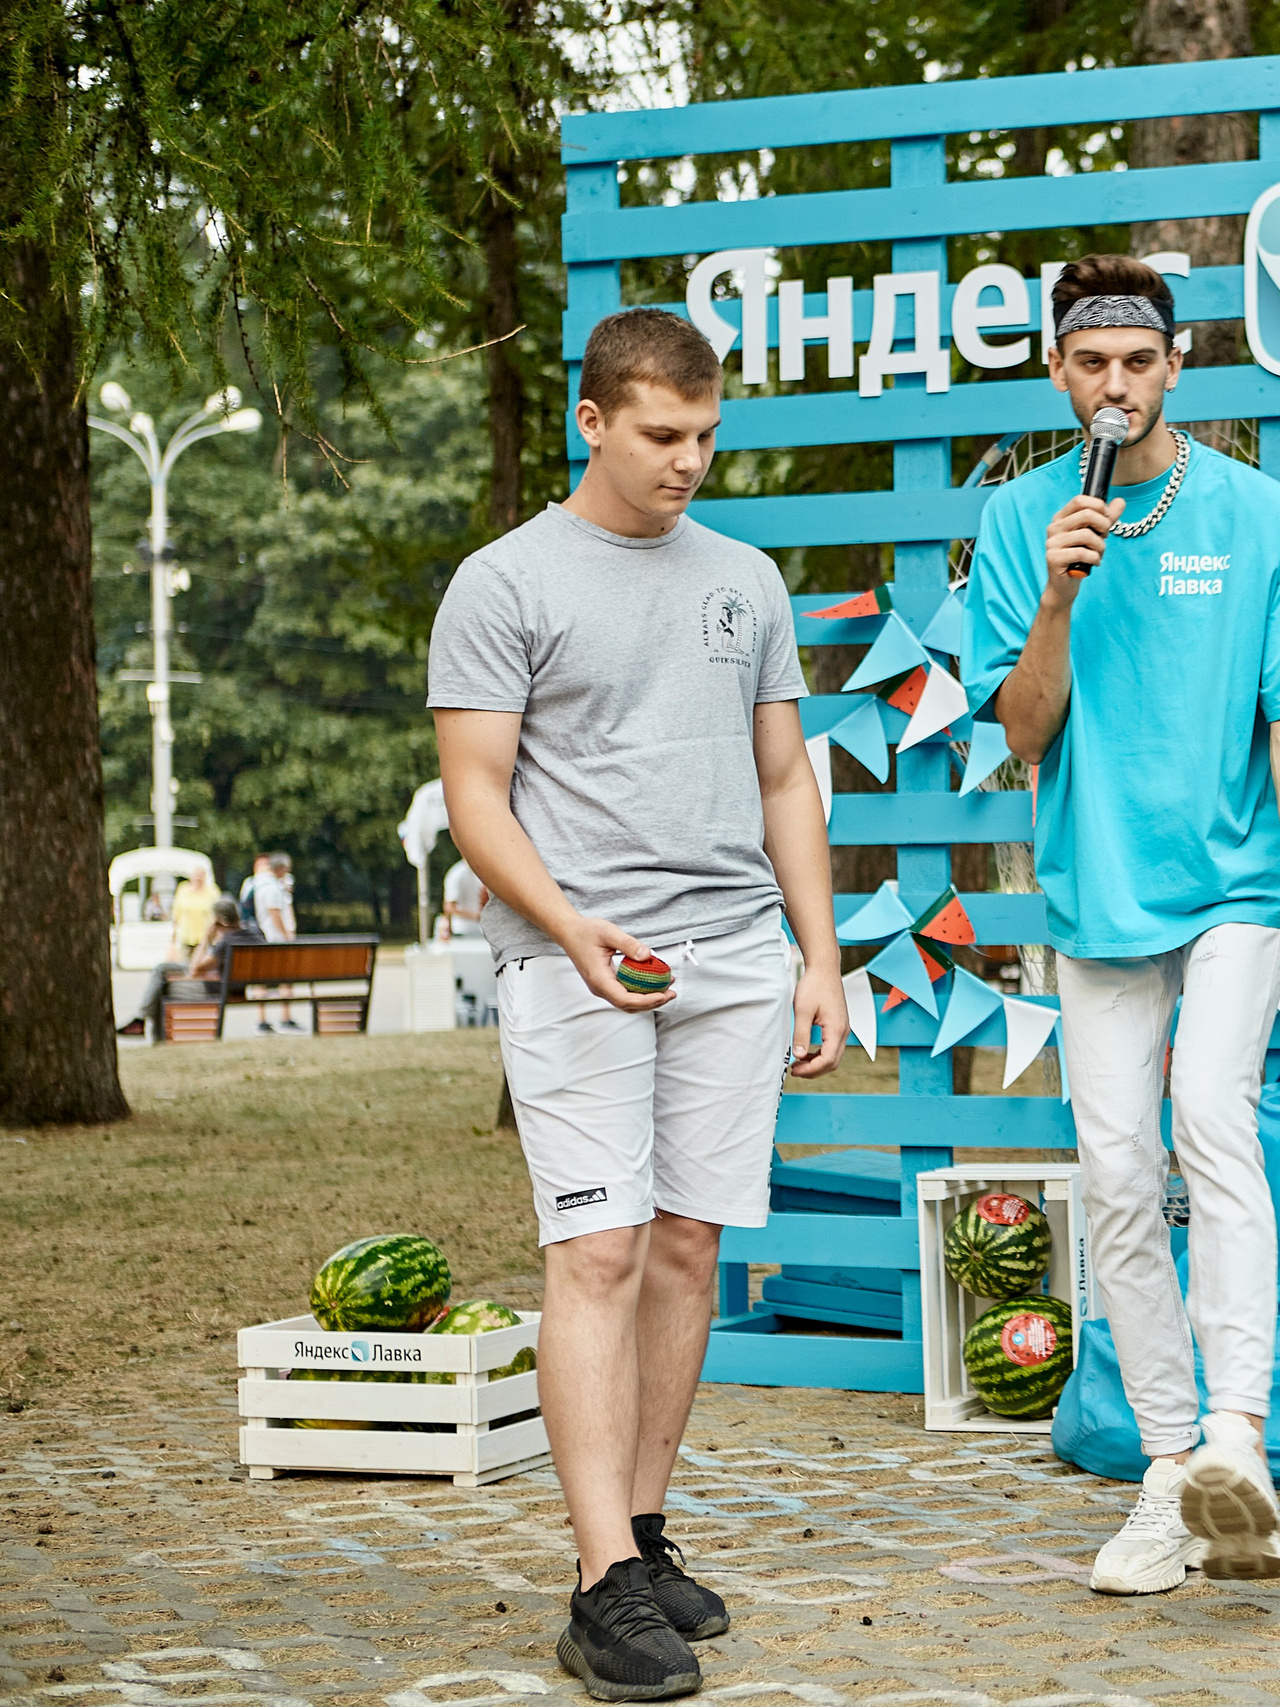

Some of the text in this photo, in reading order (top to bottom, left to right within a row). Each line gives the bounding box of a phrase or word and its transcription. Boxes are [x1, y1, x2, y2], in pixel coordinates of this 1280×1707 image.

[686, 246, 1192, 398] Янде
[1159, 551, 1231, 574] Яндекс
[1158, 575, 1223, 597] Лавка
[709, 656, 752, 669] QUIKSILVER
[557, 1194, 589, 1209] adidas
[1078, 1237, 1086, 1291] Лавка
[294, 1340, 422, 1362] Яндекс Лавка
